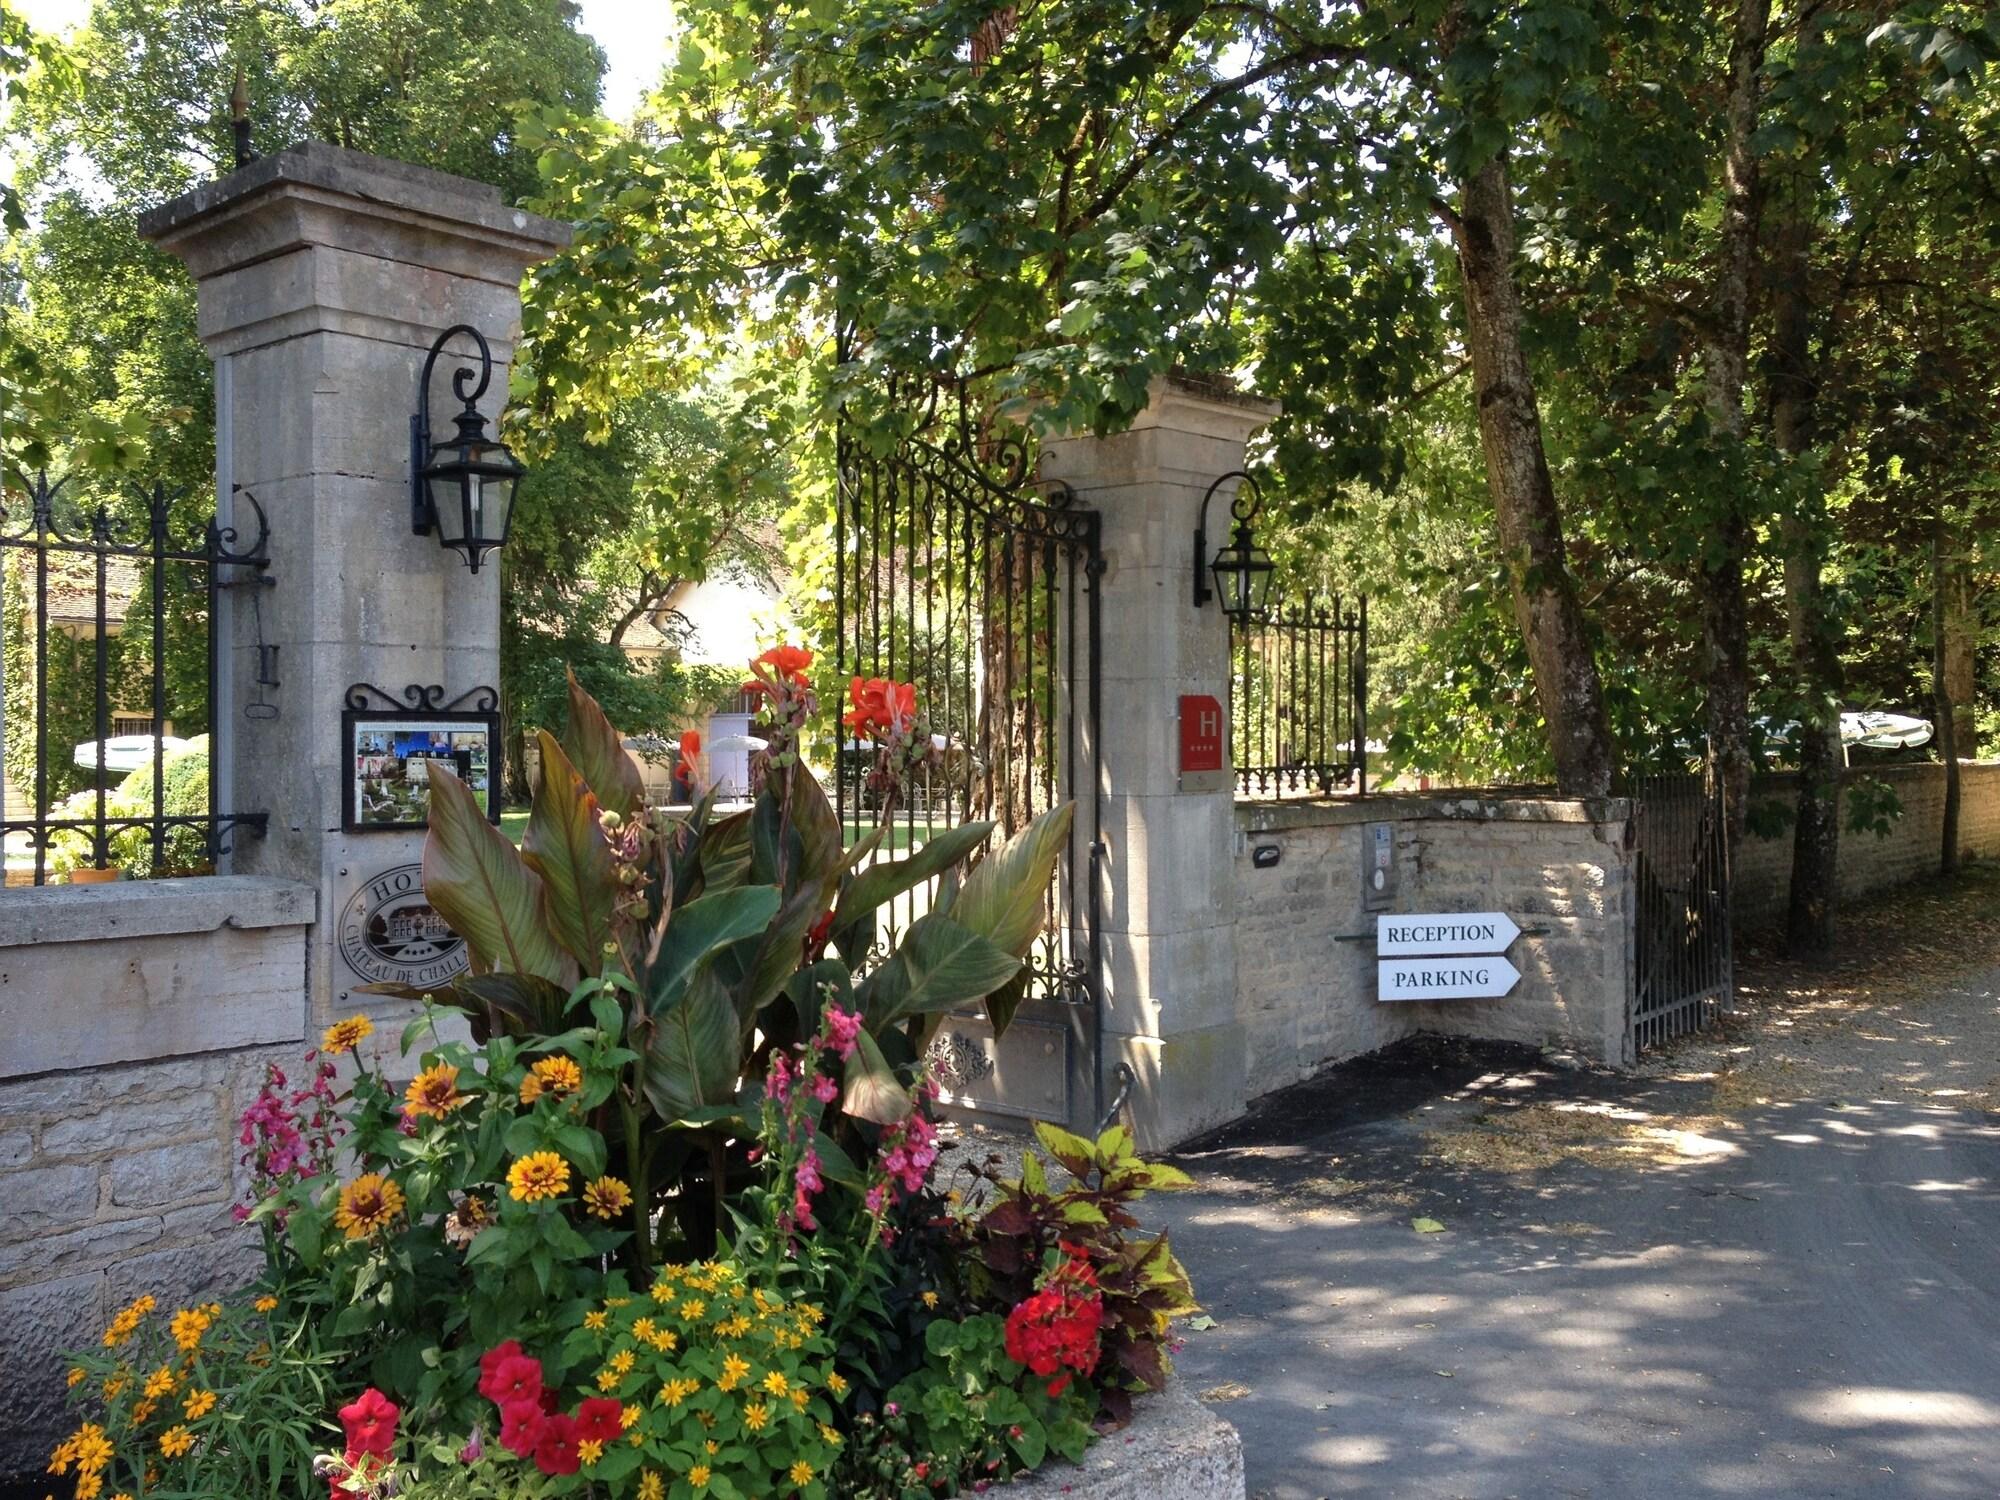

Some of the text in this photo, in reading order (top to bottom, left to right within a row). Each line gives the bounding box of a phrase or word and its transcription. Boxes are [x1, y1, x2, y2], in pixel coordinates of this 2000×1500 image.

[1199, 711, 1217, 737] H
[1387, 924, 1495, 943] RECEPTION
[346, 924, 393, 980] CHATEAU
[396, 969, 414, 983] DE
[1395, 969, 1489, 987] PARKING
